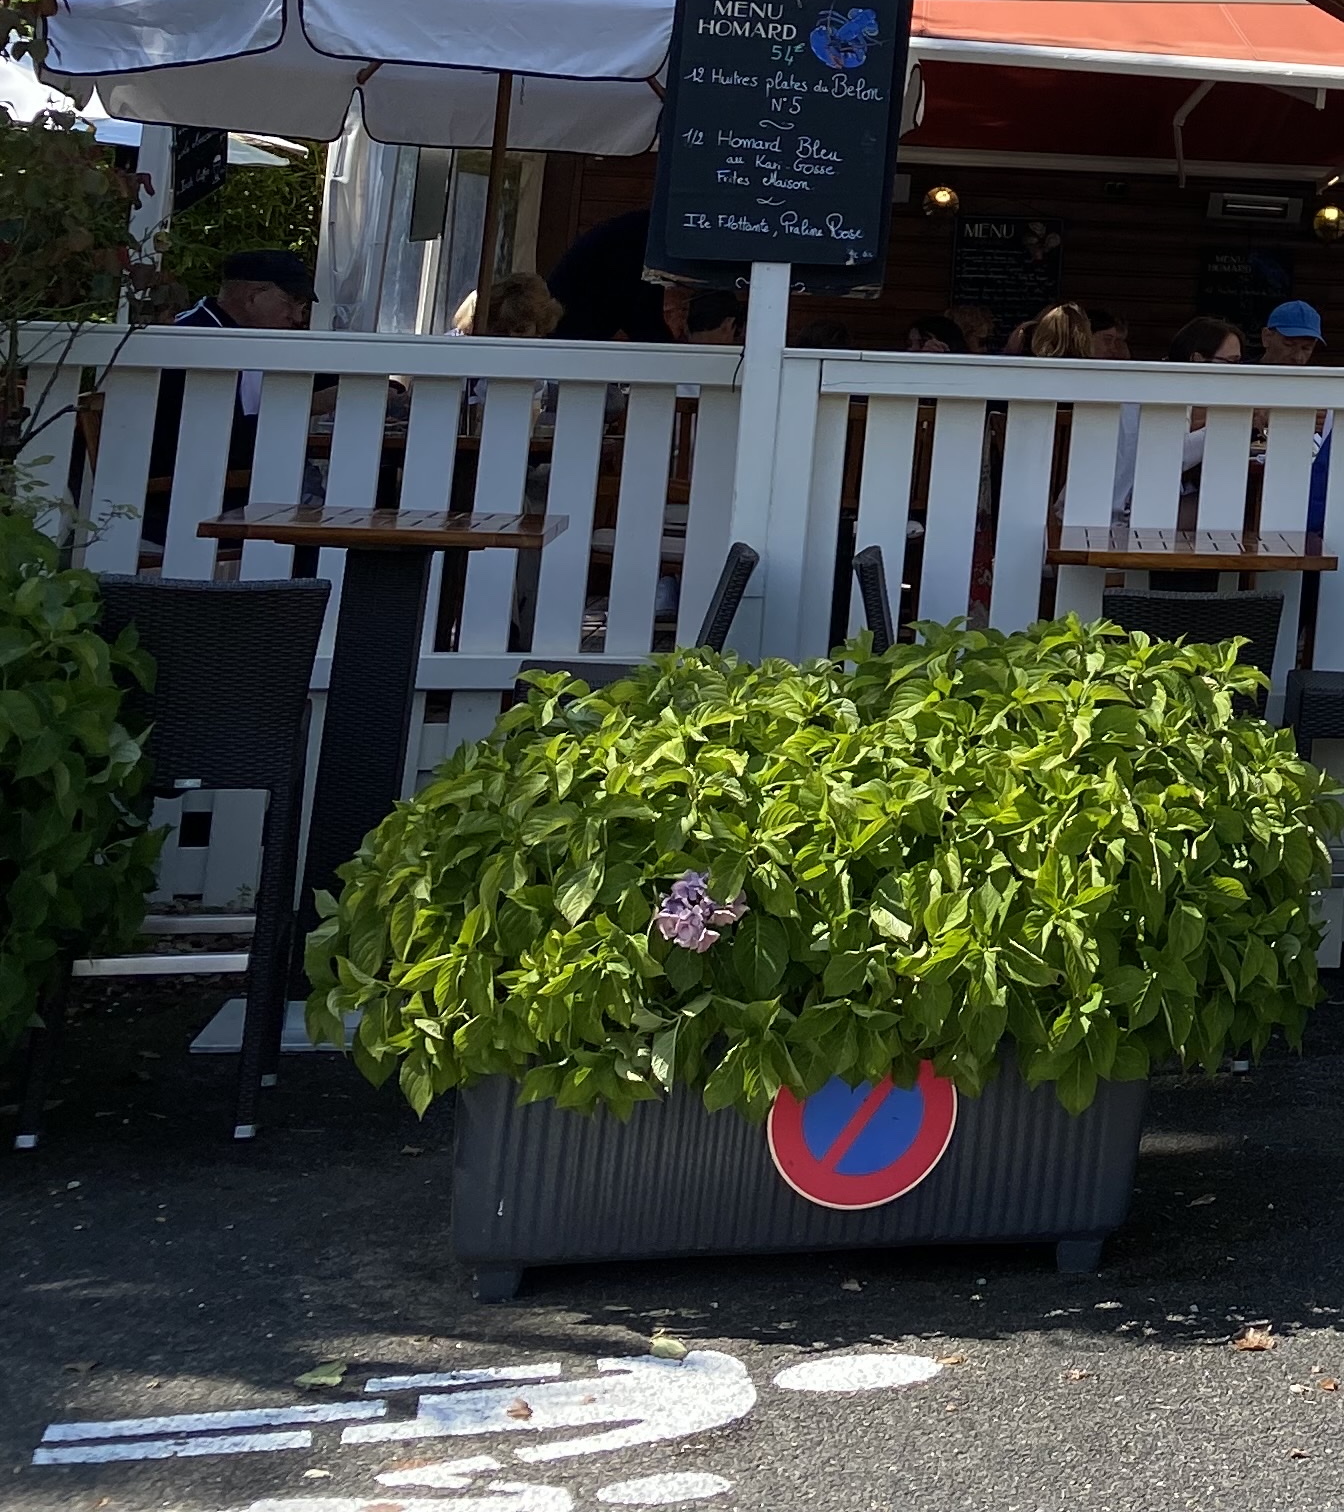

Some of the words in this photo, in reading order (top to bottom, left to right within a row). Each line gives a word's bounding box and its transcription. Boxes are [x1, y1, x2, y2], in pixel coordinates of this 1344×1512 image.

[714, 0, 784, 20] MENU
[698, 19, 797, 40] HOMARD
[684, 67, 704, 82] 12
[766, 71, 808, 97] plates
[813, 78, 829, 93] du
[831, 73, 884, 101] Belon
[682, 127, 705, 146] 1/2
[718, 130, 782, 153] Homard
[796, 136, 843, 162] Bleu
[726, 156, 745, 165] au
[716, 170, 750, 186] Frites
[762, 173, 812, 191] Maison
[683, 213, 712, 229] Ile
[780, 210, 824, 237] Praline
[826, 213, 865, 240] Rose
[963, 222, 1016, 239] MENU
